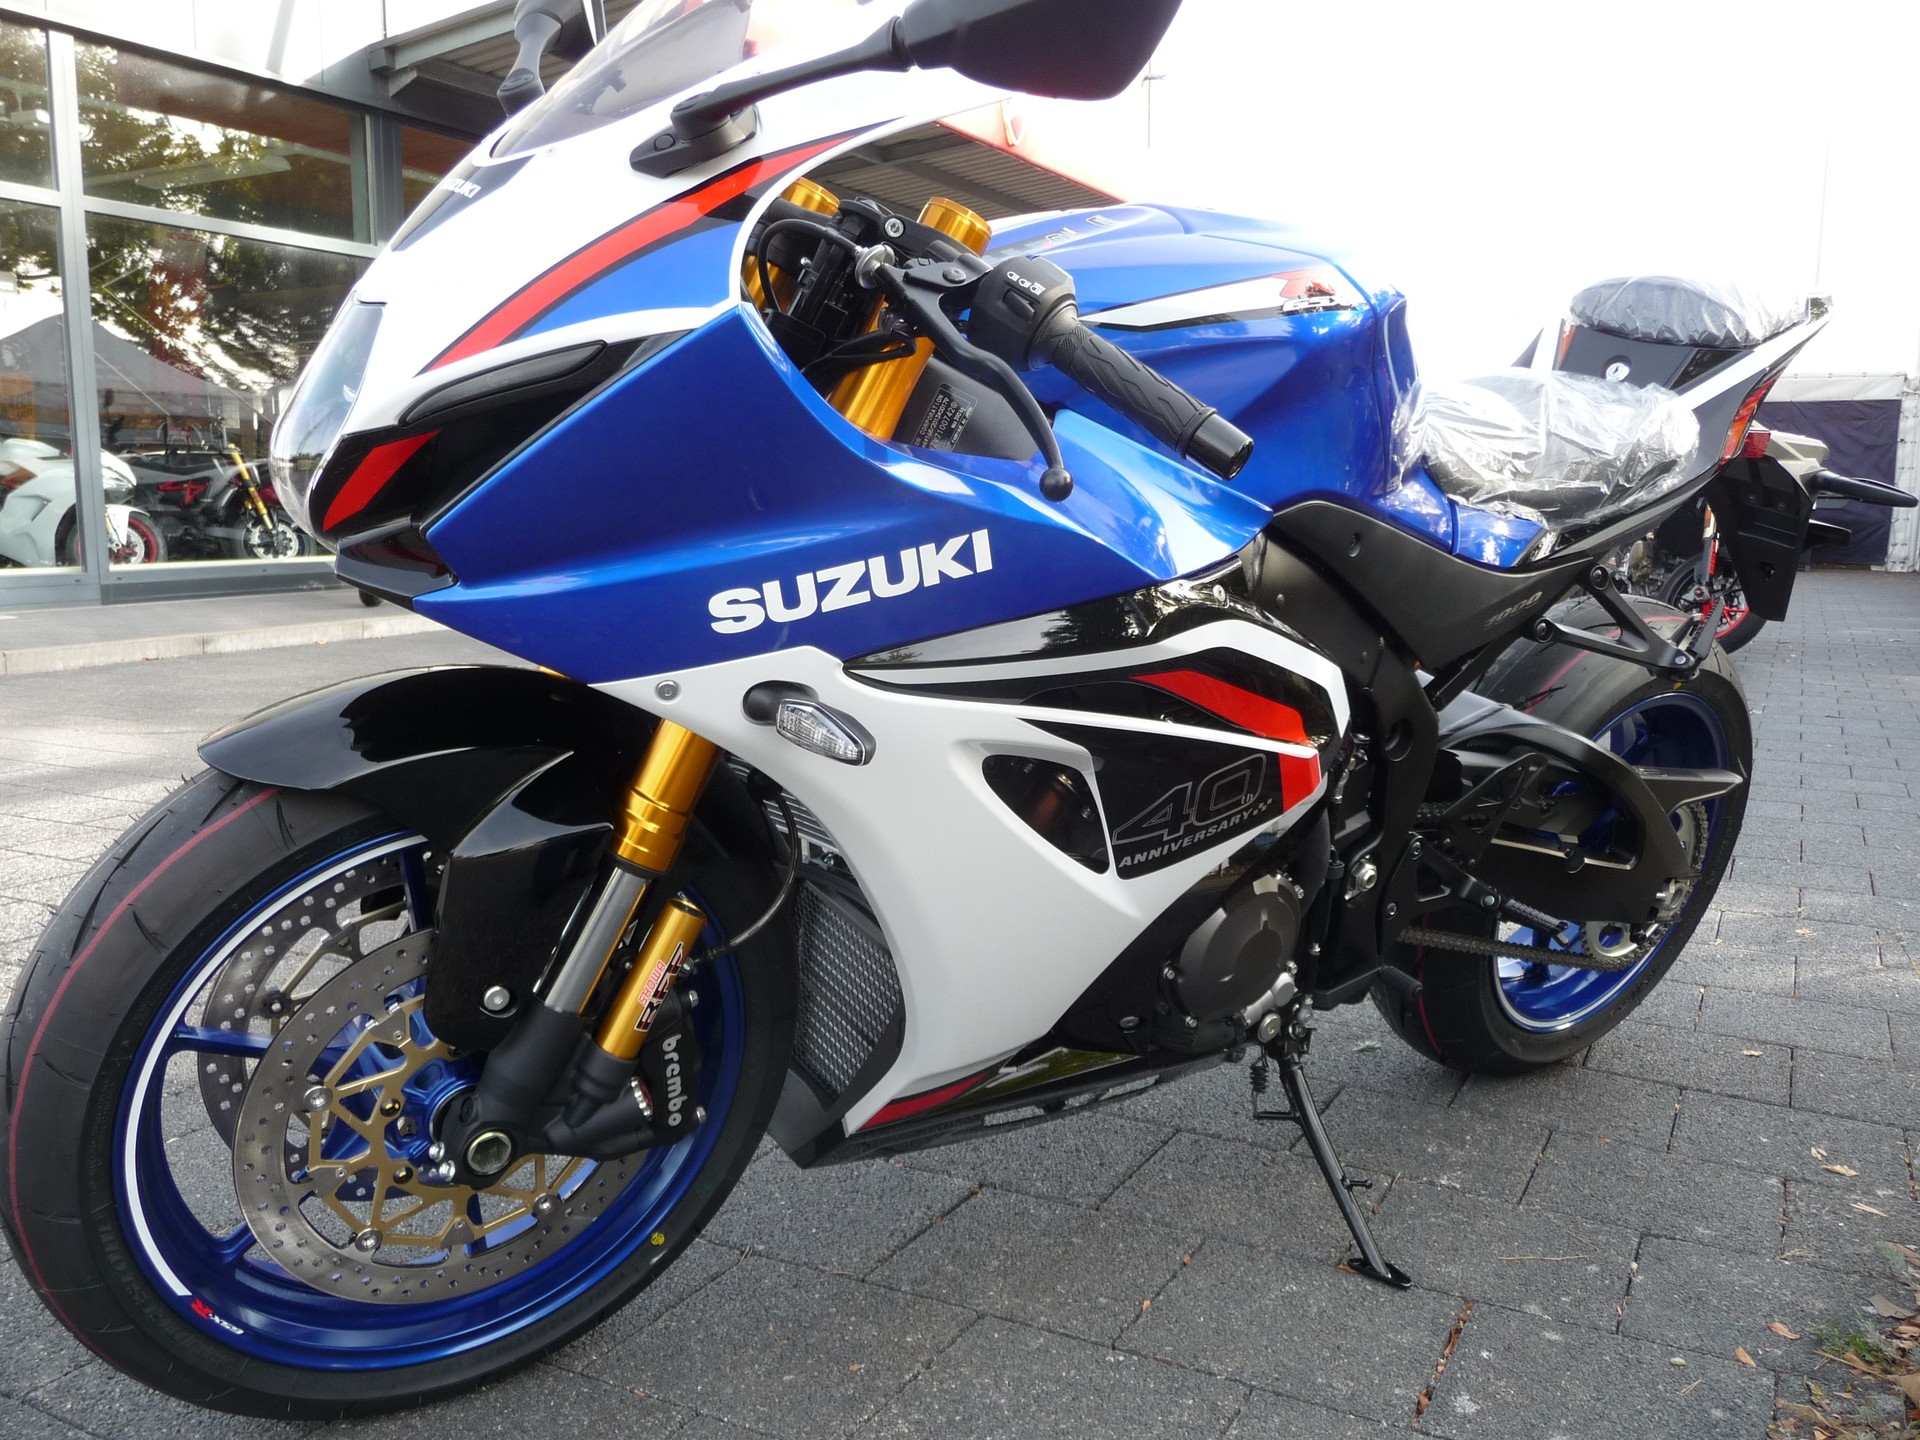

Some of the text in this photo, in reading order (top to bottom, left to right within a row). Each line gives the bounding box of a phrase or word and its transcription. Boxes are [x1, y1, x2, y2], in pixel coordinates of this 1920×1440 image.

[708, 528, 993, 634] SUZUKI
[1118, 809, 1253, 868] ANNIVERSARY
[639, 960, 666, 1006] SHOWA
[662, 1034, 688, 1127] brembo
